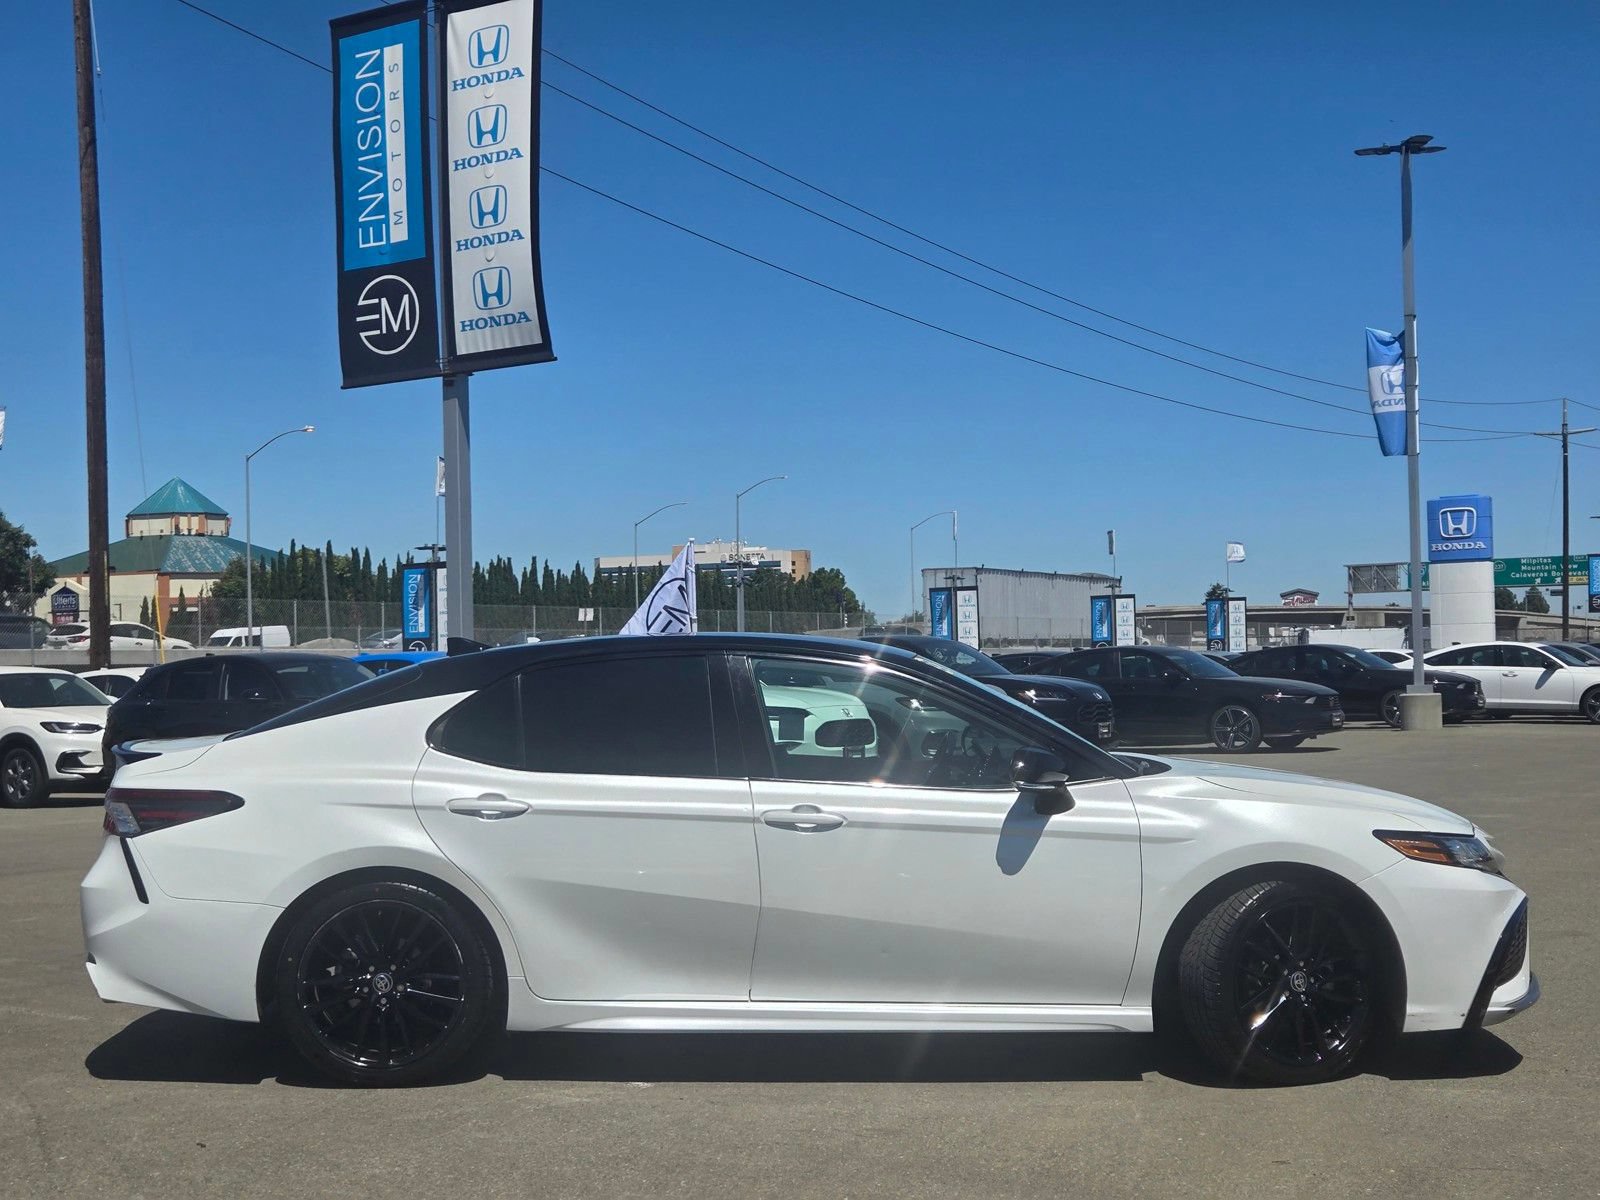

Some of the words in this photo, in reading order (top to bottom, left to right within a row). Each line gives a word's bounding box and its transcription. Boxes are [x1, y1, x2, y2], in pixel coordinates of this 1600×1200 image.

[452, 66, 525, 92] HONDA
[355, 48, 386, 249] ENVISION
[389, 62, 404, 227] MOTORS
[453, 147, 524, 172] HONDA
[455, 229, 525, 252] HONDA
[460, 311, 532, 332] HONDA
[1431, 541, 1487, 551] HONDA
[408, 574, 418, 633] ENVISION
